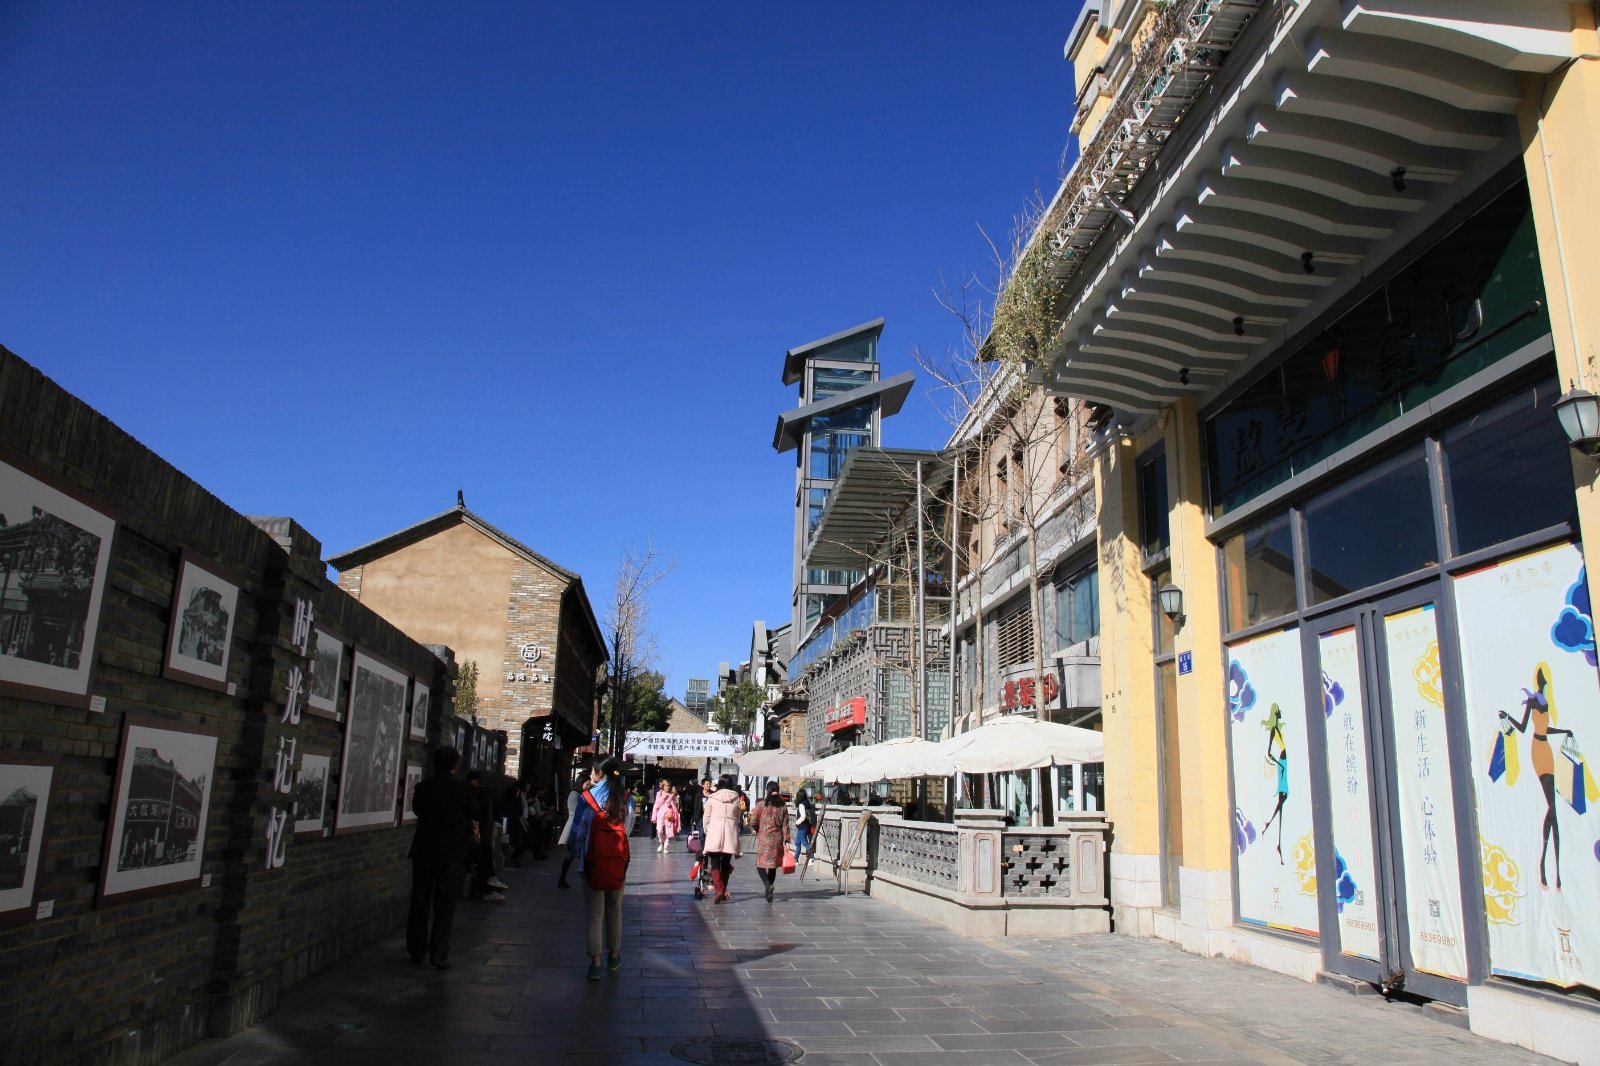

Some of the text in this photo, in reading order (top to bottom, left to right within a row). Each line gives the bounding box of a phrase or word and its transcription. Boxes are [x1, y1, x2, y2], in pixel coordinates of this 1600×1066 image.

[266, 597, 314, 869] 时光记忆
[1343, 712, 1358, 794] 就在缤纷
[1414, 710, 1437, 865] 新生活 心体验
[1346, 919, 1376, 932] 68369980
[1420, 931, 1457, 947] 68369980
